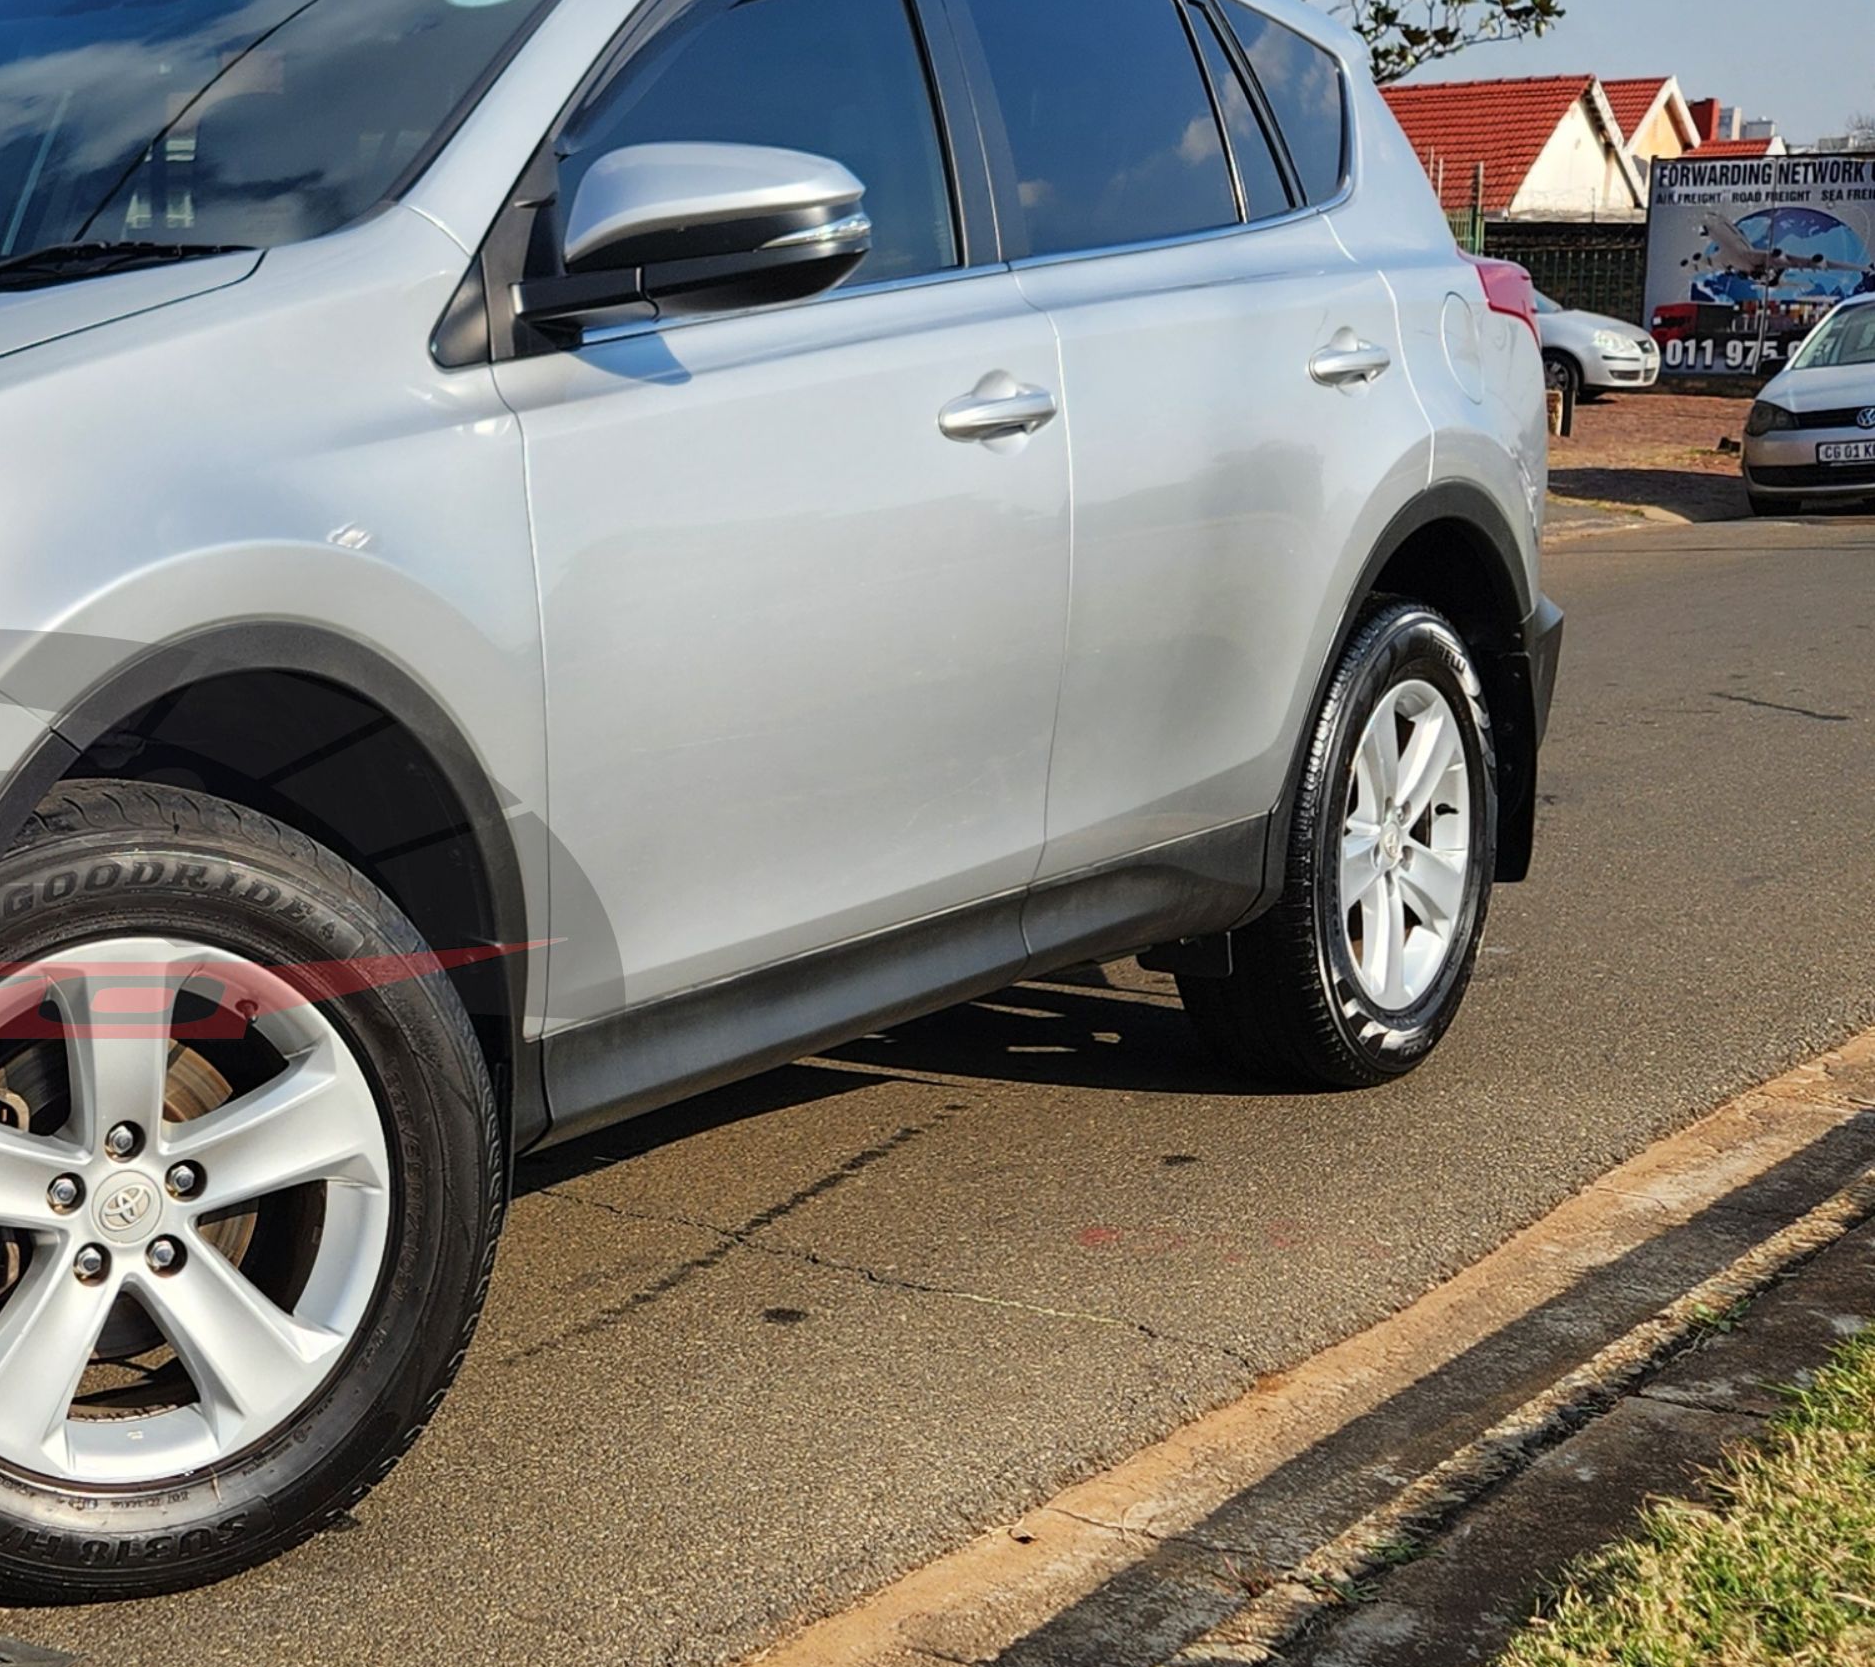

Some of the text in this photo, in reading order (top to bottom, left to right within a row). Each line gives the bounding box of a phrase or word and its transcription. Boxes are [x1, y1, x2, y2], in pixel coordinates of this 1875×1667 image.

[1659, 163, 1772, 187] FORWARDING
[1778, 160, 1865, 185] NETWORK
[1765, 190, 1811, 202] FREIGHT
[1821, 189, 1843, 202] SEA
[1666, 339, 1714, 366] 011
[1726, 340, 1779, 367] 975
[1825, 445, 1841, 459] CG
[1864, 443, 1875, 458] K
[2, 860, 315, 924] GOODRIDE
